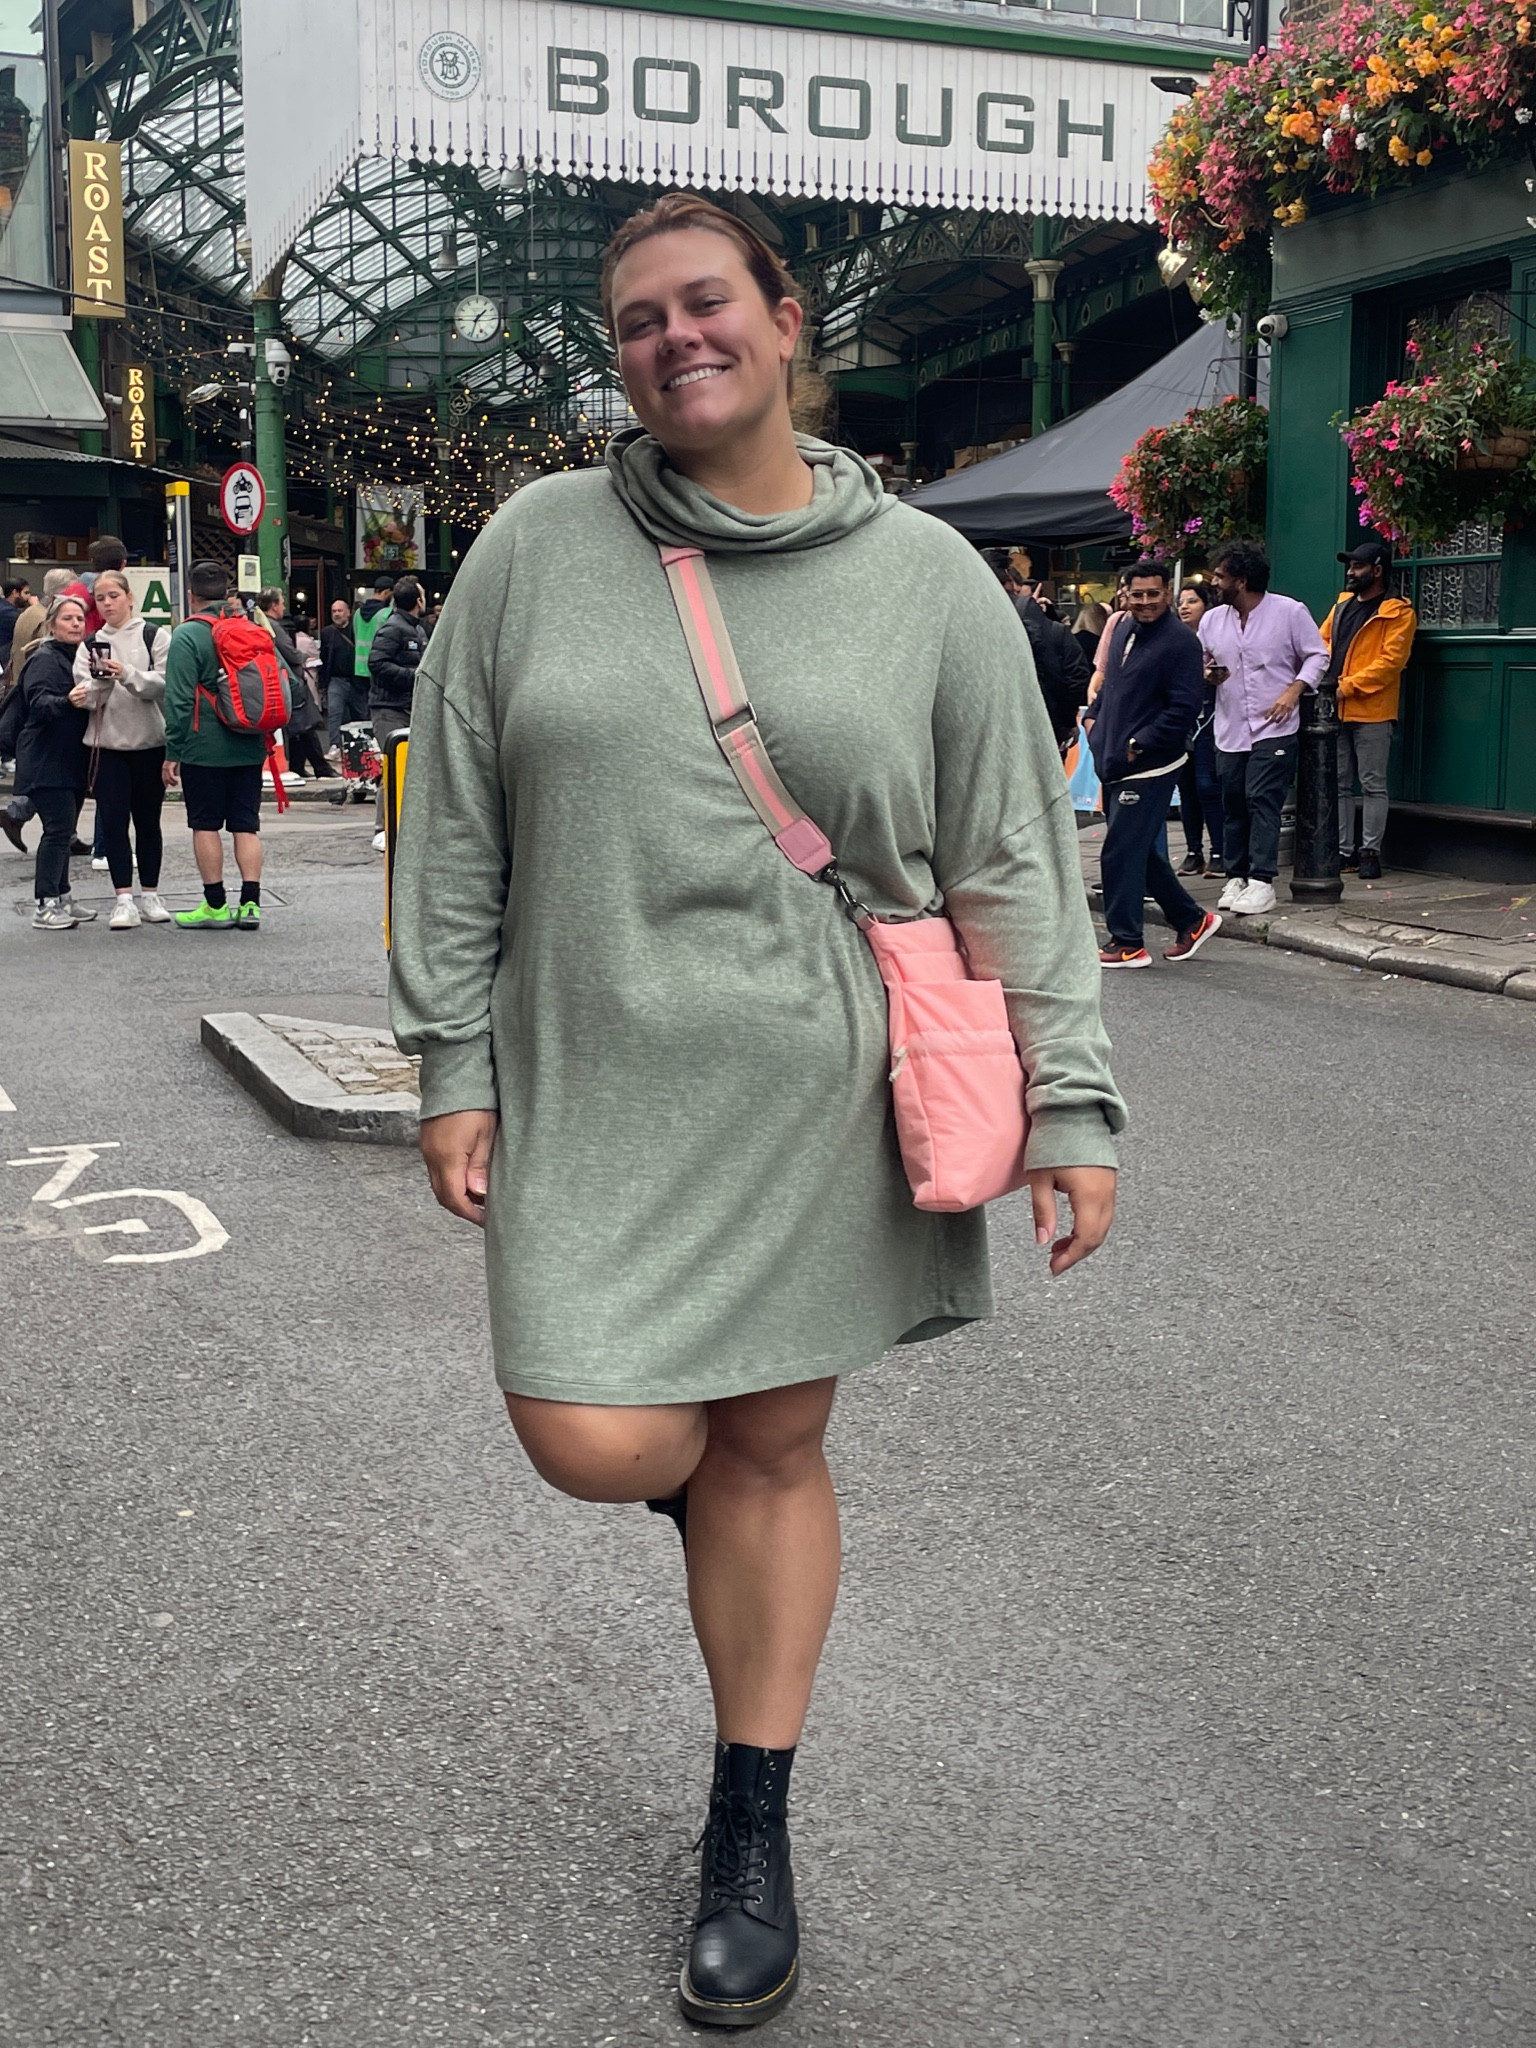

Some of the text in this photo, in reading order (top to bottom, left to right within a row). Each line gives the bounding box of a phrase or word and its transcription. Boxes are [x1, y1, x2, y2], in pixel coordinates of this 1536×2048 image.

[421, 36, 479, 79] BOROUGH MARKET
[546, 46, 1115, 162] BOROUGH
[83, 151, 113, 306] ROAST
[128, 368, 146, 459] ROAST
